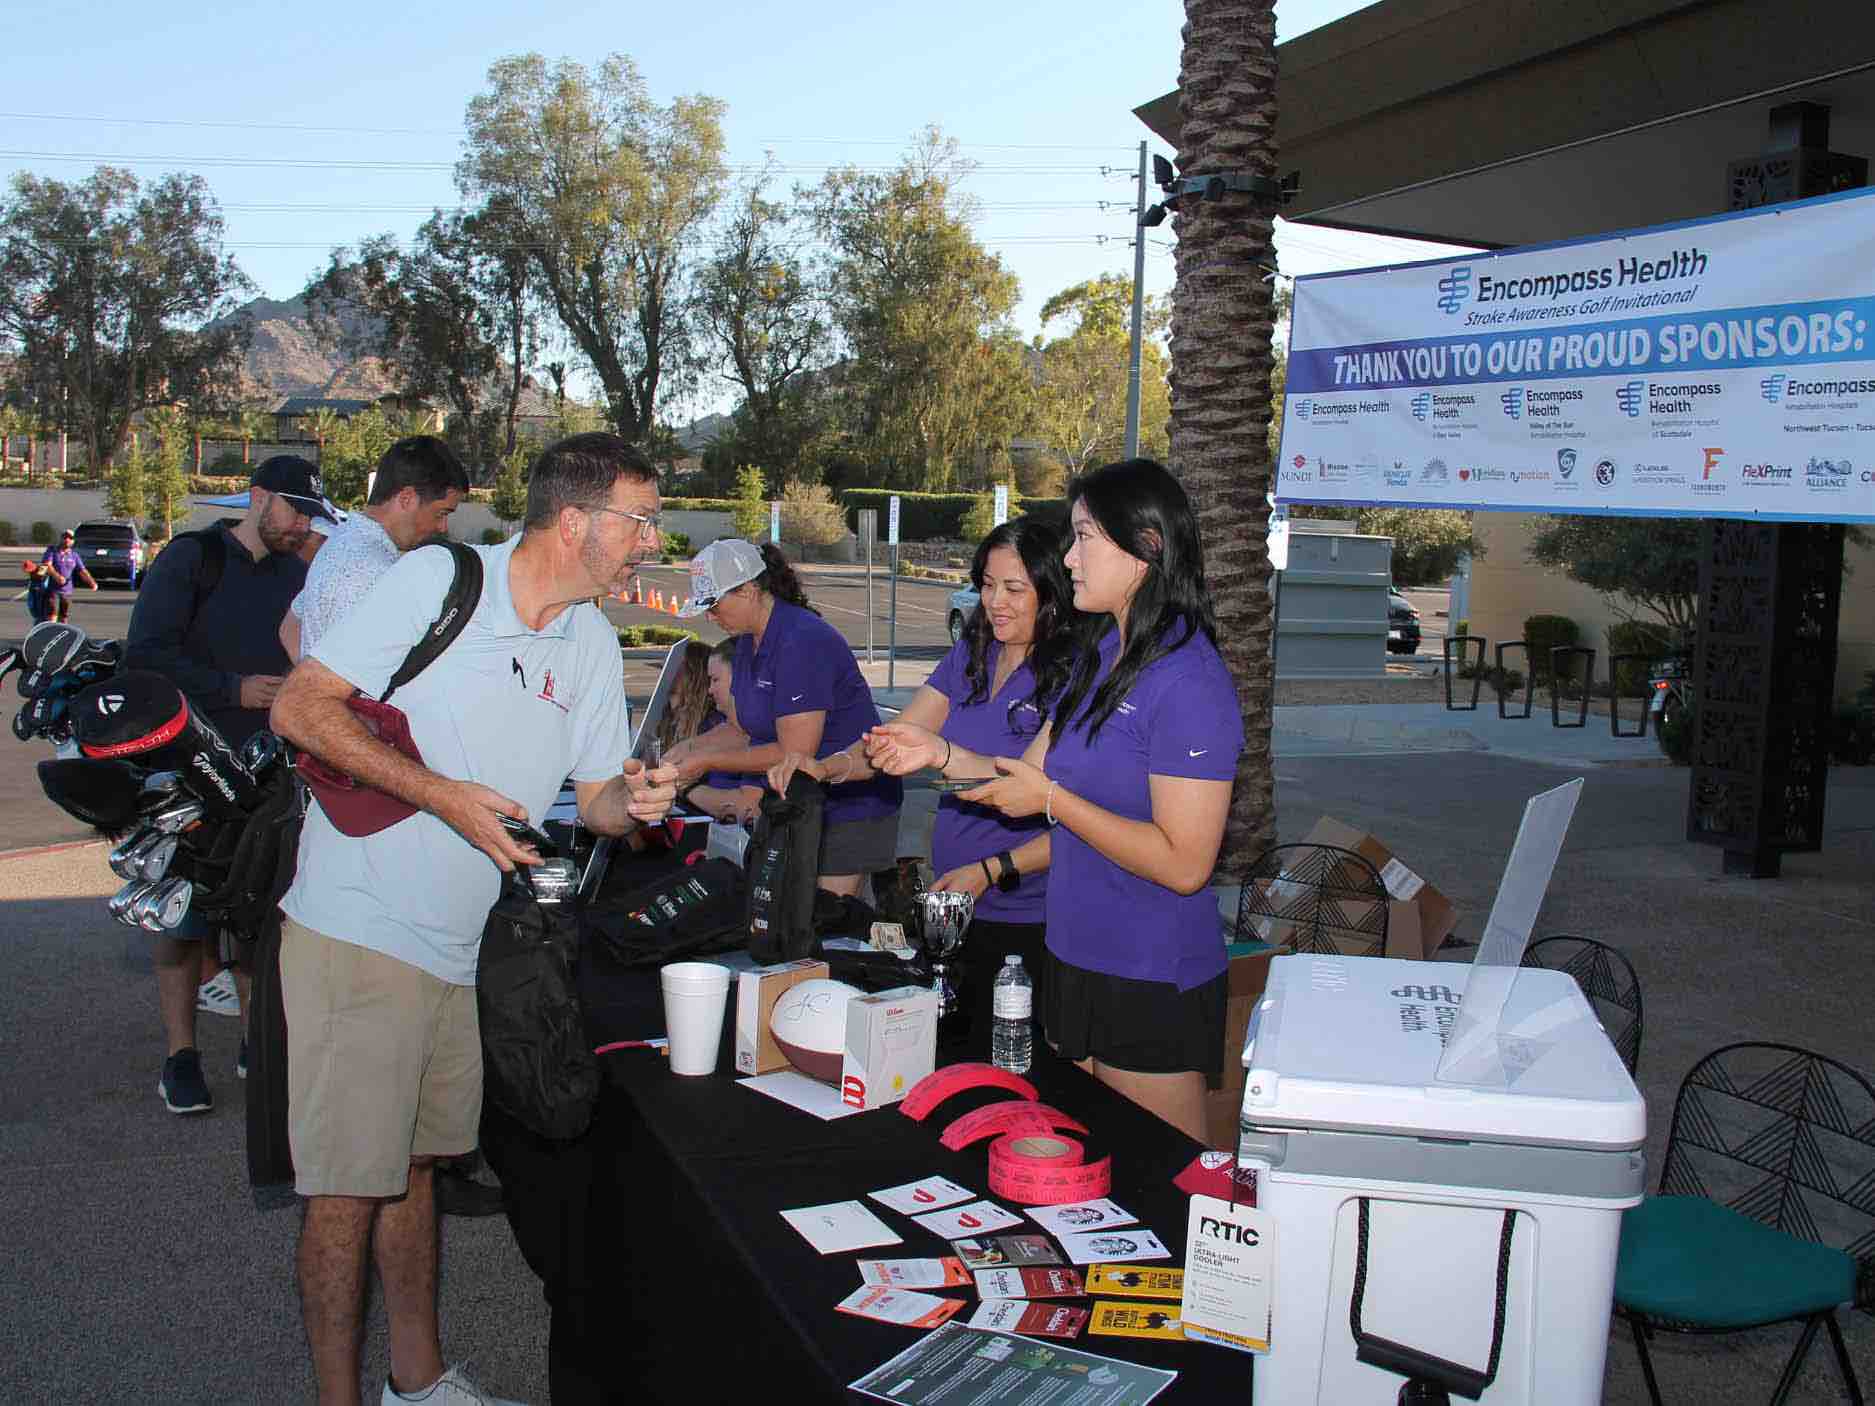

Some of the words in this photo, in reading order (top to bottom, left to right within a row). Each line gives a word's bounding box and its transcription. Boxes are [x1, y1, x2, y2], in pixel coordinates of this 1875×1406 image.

[1477, 265, 1613, 302] Encompass
[1617, 248, 1708, 287] Health
[1464, 307, 1506, 327] Stroke
[1506, 302, 1577, 324] Awareness
[1579, 295, 1612, 315] Golf
[1610, 284, 1699, 312] Invitational
[1333, 350, 1403, 385] THANK
[1403, 345, 1447, 380] YOU
[1448, 342, 1483, 377] TO
[1486, 335, 1544, 374] OUR
[1548, 328, 1650, 371] PROUD
[1659, 310, 1867, 363] SPONSORS:
[1526, 388, 1584, 405] Encompass
[1649, 383, 1722, 398] Encompass
[1786, 380, 1875, 397] Encompass
[1312, 402, 1357, 417] Encompass
[1358, 400, 1390, 414] Health
[1433, 394, 1475, 407] Encompass
[1650, 399, 1692, 414] Health
[1433, 407, 1460, 418] Health
[1527, 404, 1560, 417] Health
[1200, 1215, 1260, 1246] RTIC
